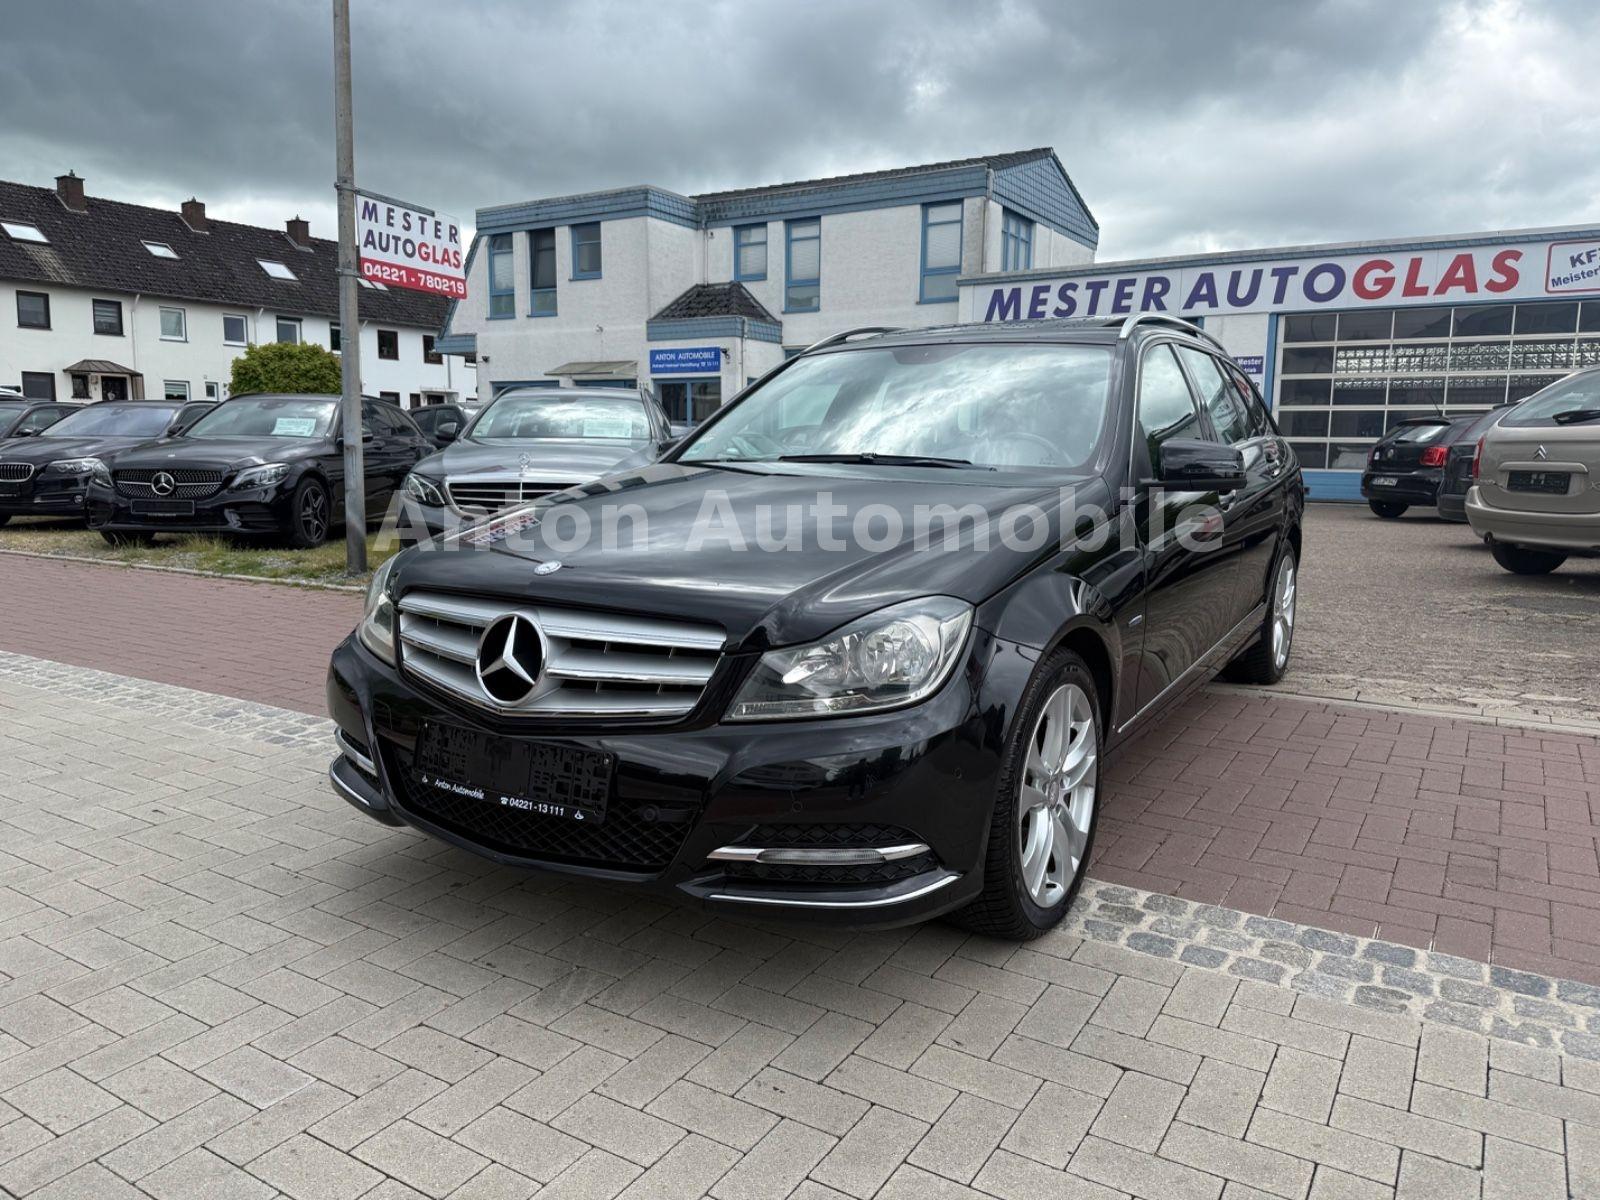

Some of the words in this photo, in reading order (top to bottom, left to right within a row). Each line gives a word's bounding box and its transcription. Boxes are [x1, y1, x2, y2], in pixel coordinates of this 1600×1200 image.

[362, 201, 458, 244] MESTER
[363, 229, 462, 269] AUTOGLAS
[1570, 248, 1600, 268] KF
[984, 276, 1171, 322] MESTER
[1182, 249, 1523, 310] AUTOGLAS
[1551, 266, 1600, 287] Meister
[655, 353, 676, 361] ANTON
[678, 351, 715, 360] AUTOMOBILE
[435, 778, 451, 791] Anton
[451, 782, 485, 800] Automobile
